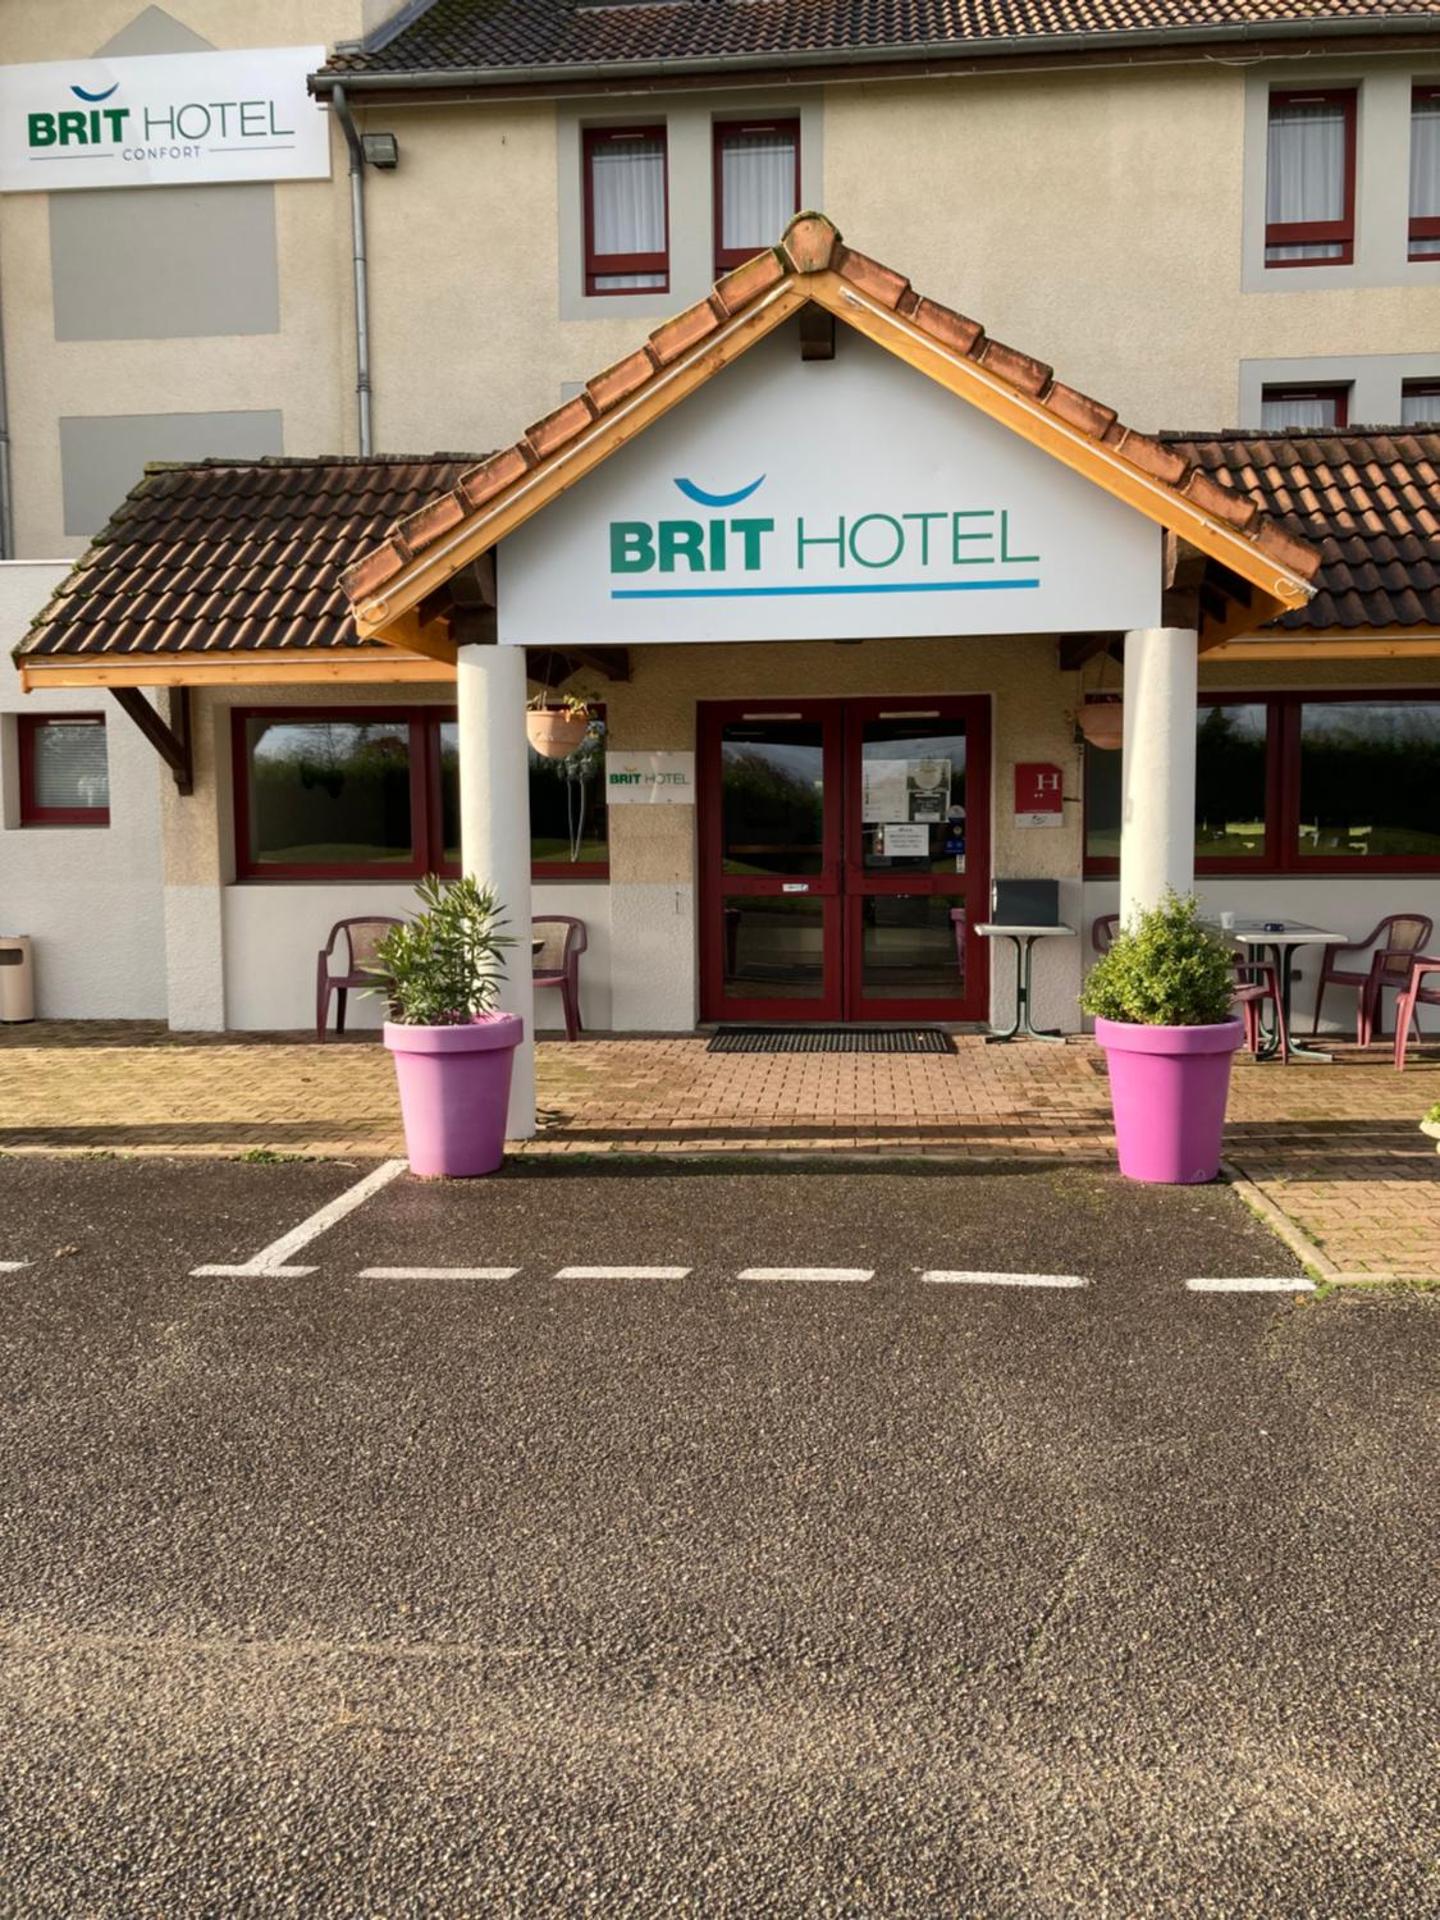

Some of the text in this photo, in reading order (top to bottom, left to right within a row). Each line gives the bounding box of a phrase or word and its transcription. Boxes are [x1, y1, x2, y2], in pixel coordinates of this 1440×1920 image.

[28, 100, 295, 147] BRIT HOTEL
[122, 145, 201, 161] CONFORT
[610, 510, 1040, 573] BRIT HOTEL
[609, 772, 691, 785] BRIT HOTEL
[1037, 773, 1059, 790] H
